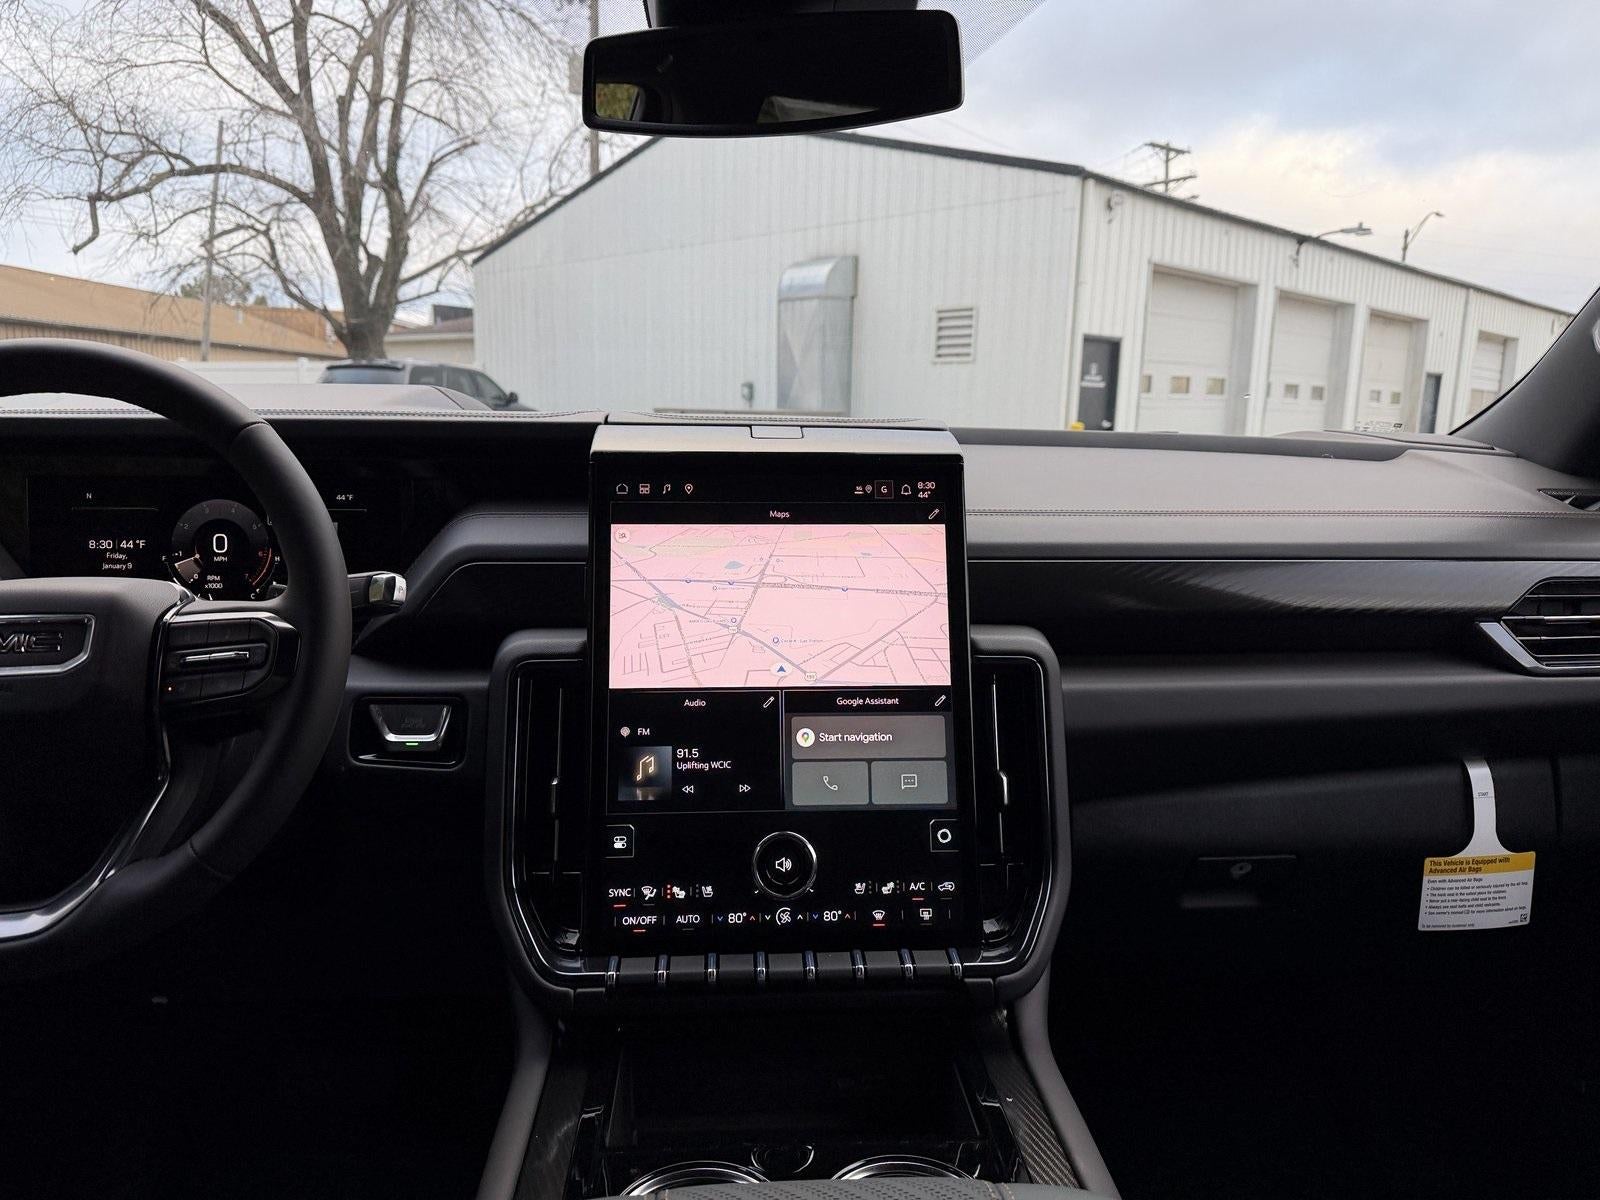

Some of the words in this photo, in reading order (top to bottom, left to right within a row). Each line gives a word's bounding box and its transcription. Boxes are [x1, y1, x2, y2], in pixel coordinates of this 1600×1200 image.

[918, 491, 931, 499] 44°
[769, 510, 790, 519] Maps
[89, 540, 113, 549] 8:30
[120, 540, 134, 549] 44
[213, 534, 227, 553] 0
[106, 552, 127, 560] Friday,
[102, 563, 125, 571] January
[684, 698, 706, 707] Audio
[837, 696, 862, 707] Google
[865, 696, 899, 706] Assistant
[638, 728, 650, 736] FM
[819, 731, 841, 742] Start
[844, 731, 892, 744] navigation
[677, 748, 699, 758] 91.5
[676, 761, 708, 771] Uplifting
[711, 761, 731, 769] WCIC
[910, 882, 925, 891] A/C
[609, 888, 631, 898] SYNC
[622, 916, 657, 925] ON/OFF
[676, 915, 700, 924] AUTO
[728, 912, 746, 923] 80°
[823, 911, 841, 922] 80°
